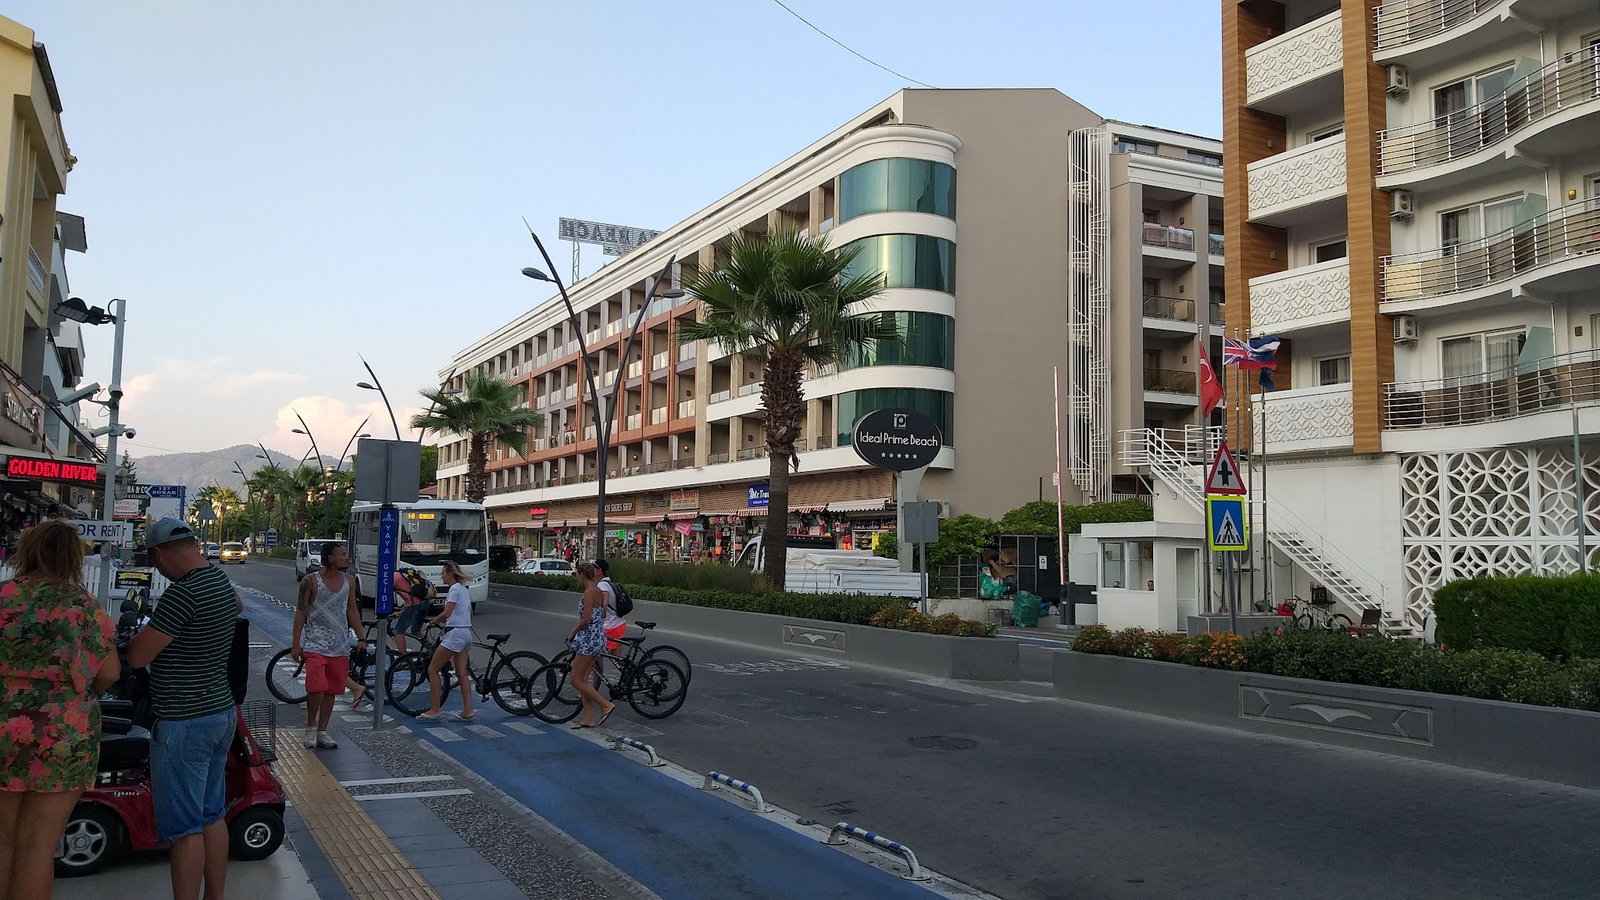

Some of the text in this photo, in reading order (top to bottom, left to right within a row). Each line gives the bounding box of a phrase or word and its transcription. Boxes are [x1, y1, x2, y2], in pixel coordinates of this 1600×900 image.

[860, 431, 938, 447] Ideal Prime Beach
[9, 458, 97, 481] GOLDEN RIVER
[79, 524, 96, 537] OR
[101, 525, 121, 537] RENT
[384, 524, 392, 554] YAYA
